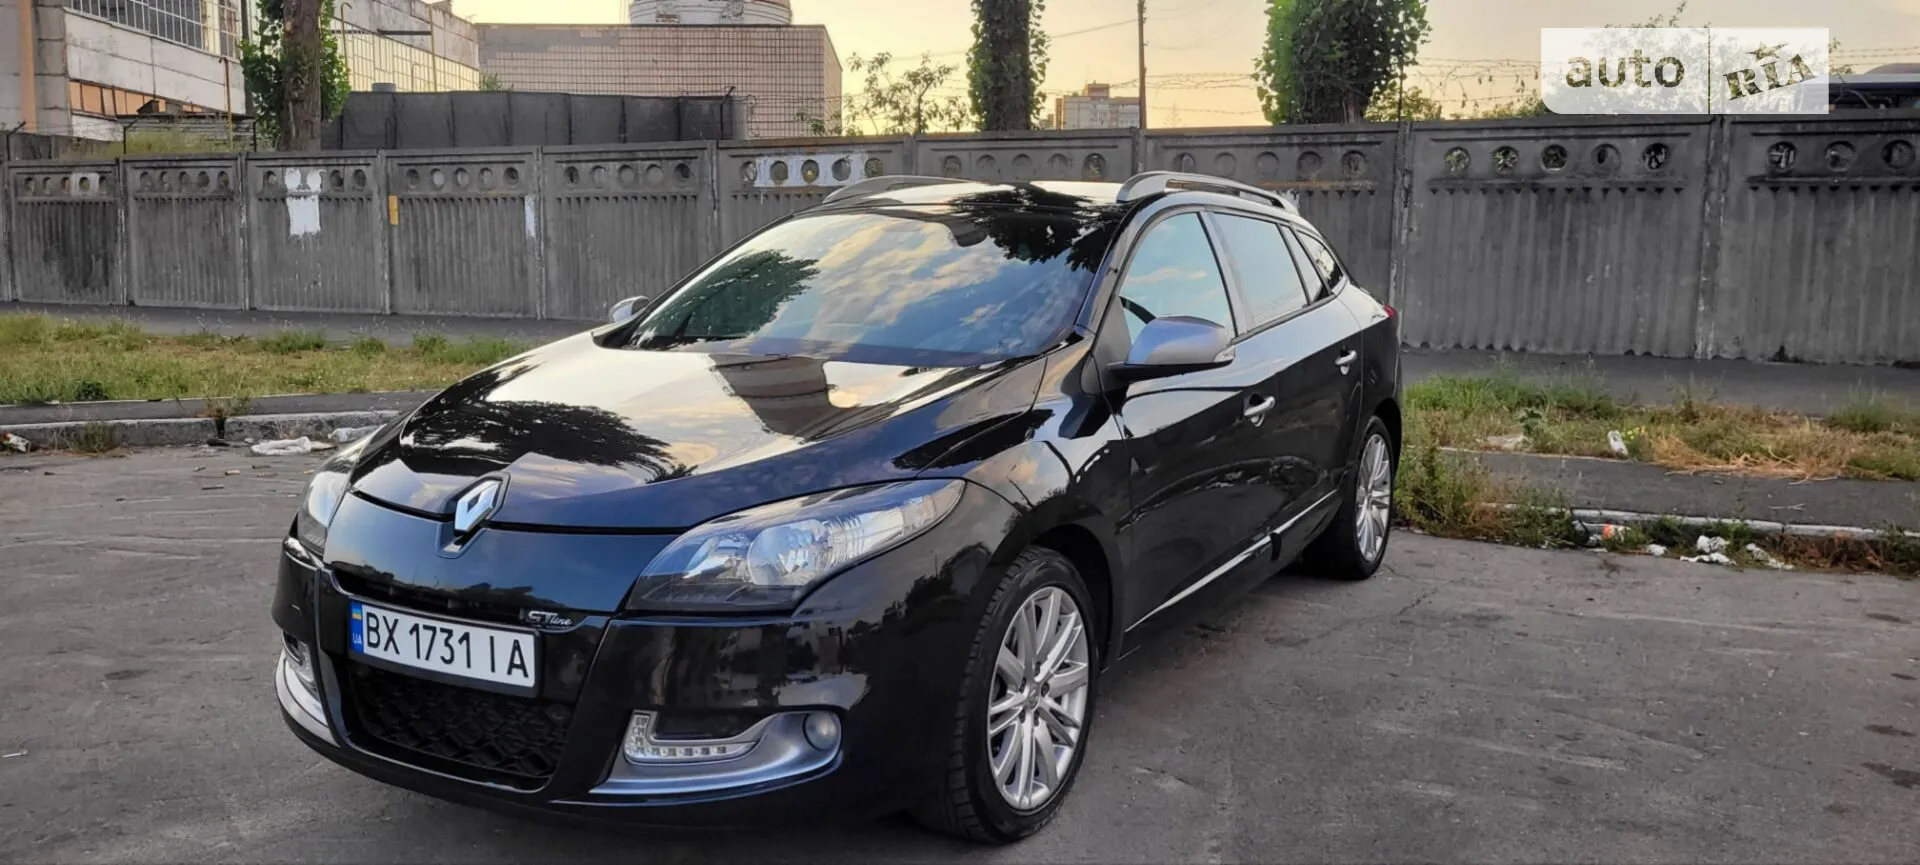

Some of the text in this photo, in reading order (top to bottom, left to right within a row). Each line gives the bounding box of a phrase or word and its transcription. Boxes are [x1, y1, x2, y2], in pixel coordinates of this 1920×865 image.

[352, 632, 363, 645] UA
[366, 612, 529, 678] BX 1731 IA
